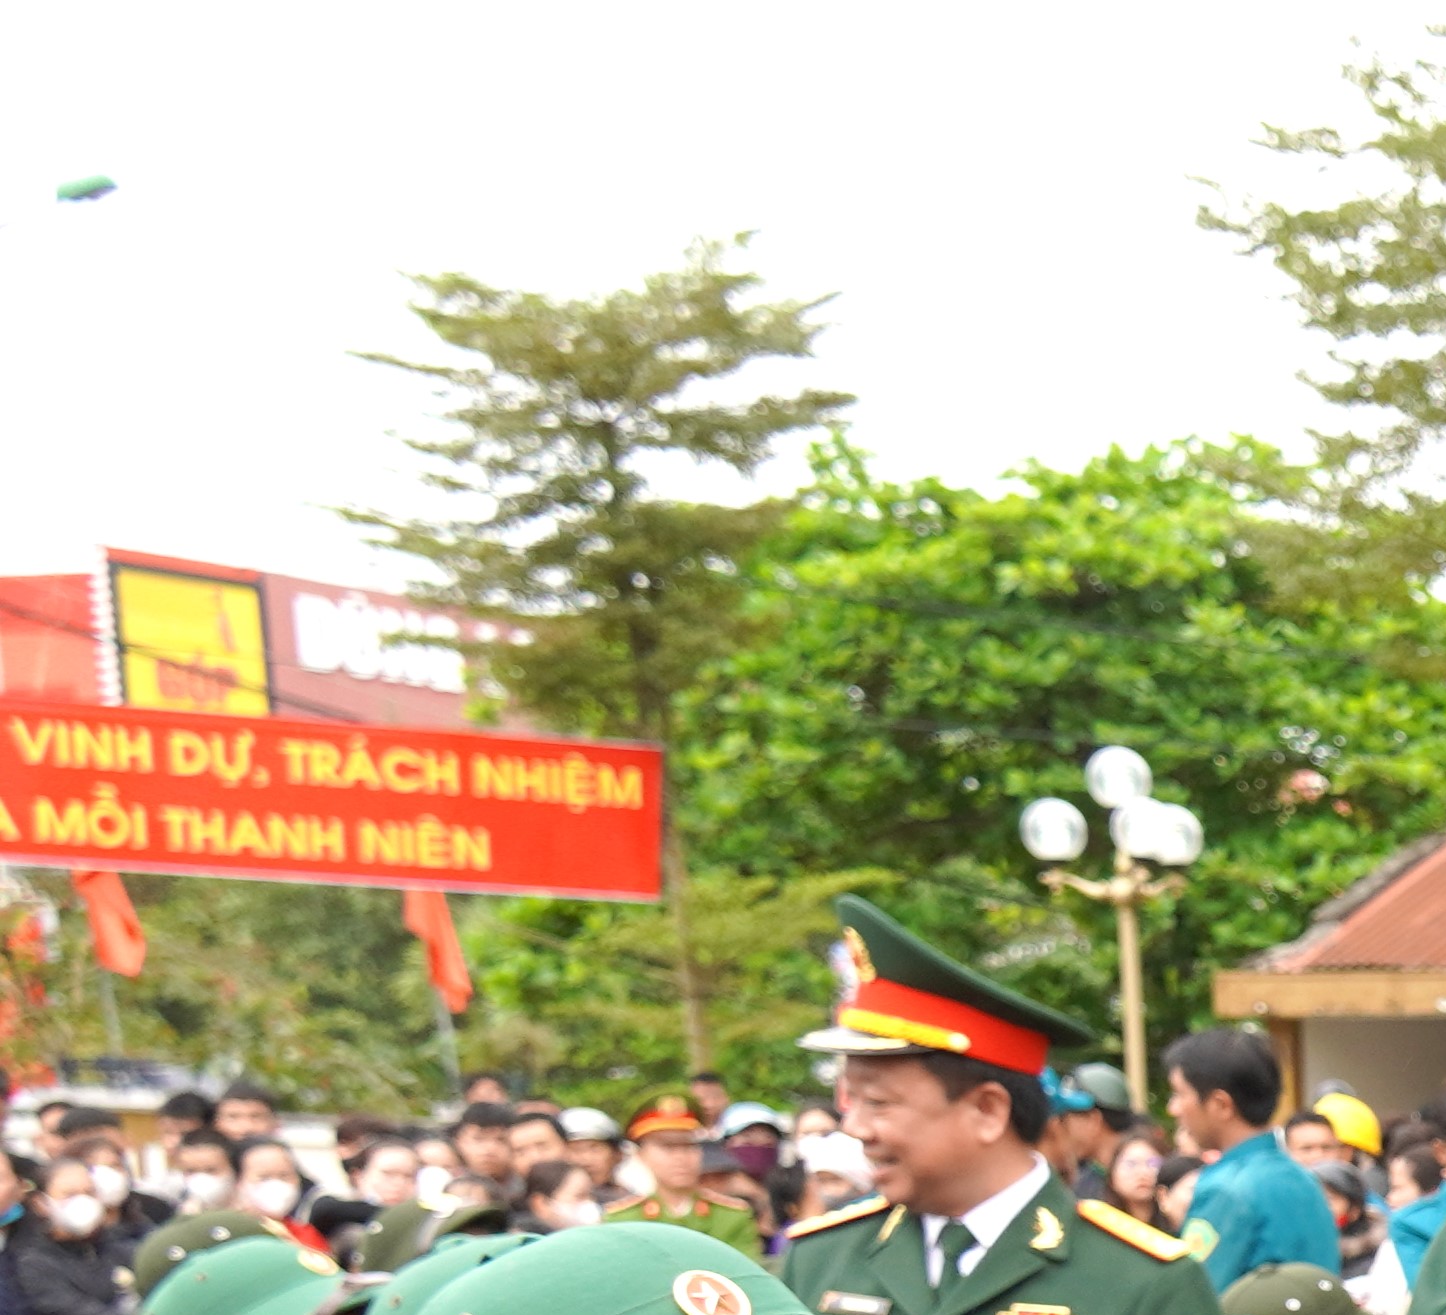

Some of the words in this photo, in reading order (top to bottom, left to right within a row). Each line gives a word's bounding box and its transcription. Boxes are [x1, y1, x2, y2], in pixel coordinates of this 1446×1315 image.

[11, 717, 153, 772] VINH
[168, 728, 270, 788] DỰ,
[282, 733, 460, 796] TRÁCH
[470, 752, 643, 814] NHIỆM
[160, 804, 346, 862] THANH
[358, 813, 492, 872] NIÊN
